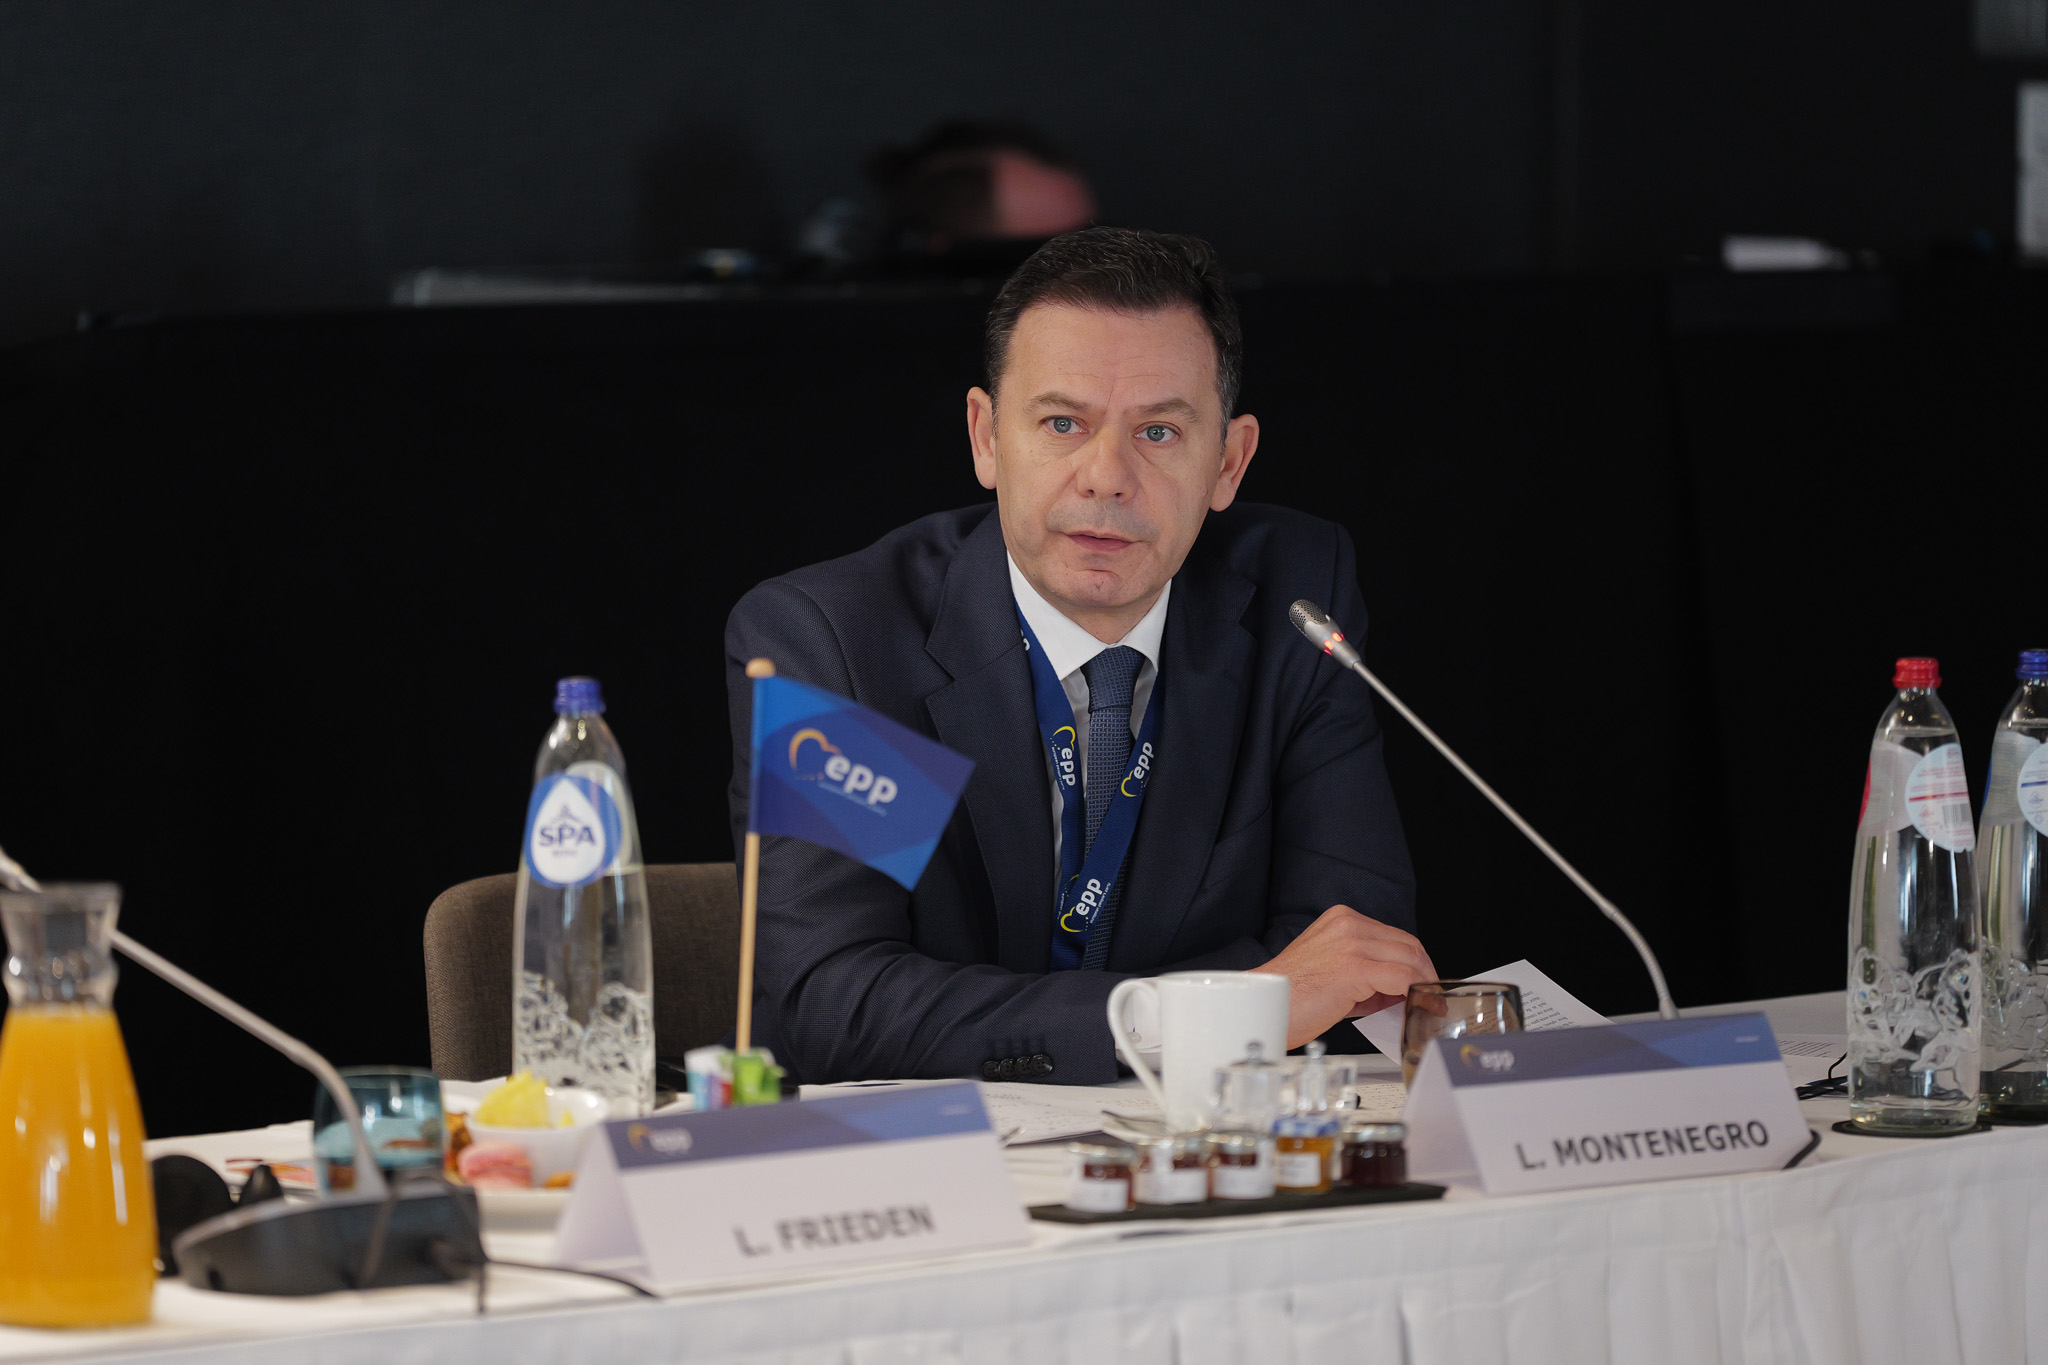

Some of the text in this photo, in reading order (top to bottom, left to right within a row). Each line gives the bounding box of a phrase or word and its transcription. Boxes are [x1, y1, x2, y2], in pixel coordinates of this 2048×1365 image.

[824, 755, 898, 805] epp
[1060, 747, 1076, 786] epp
[1133, 741, 1155, 780] epp
[539, 826, 596, 847] SPA
[1075, 878, 1103, 916] epp
[1515, 1120, 1769, 1171] L. MONTENEGRO
[732, 1203, 936, 1257] L. FRIEDEN
